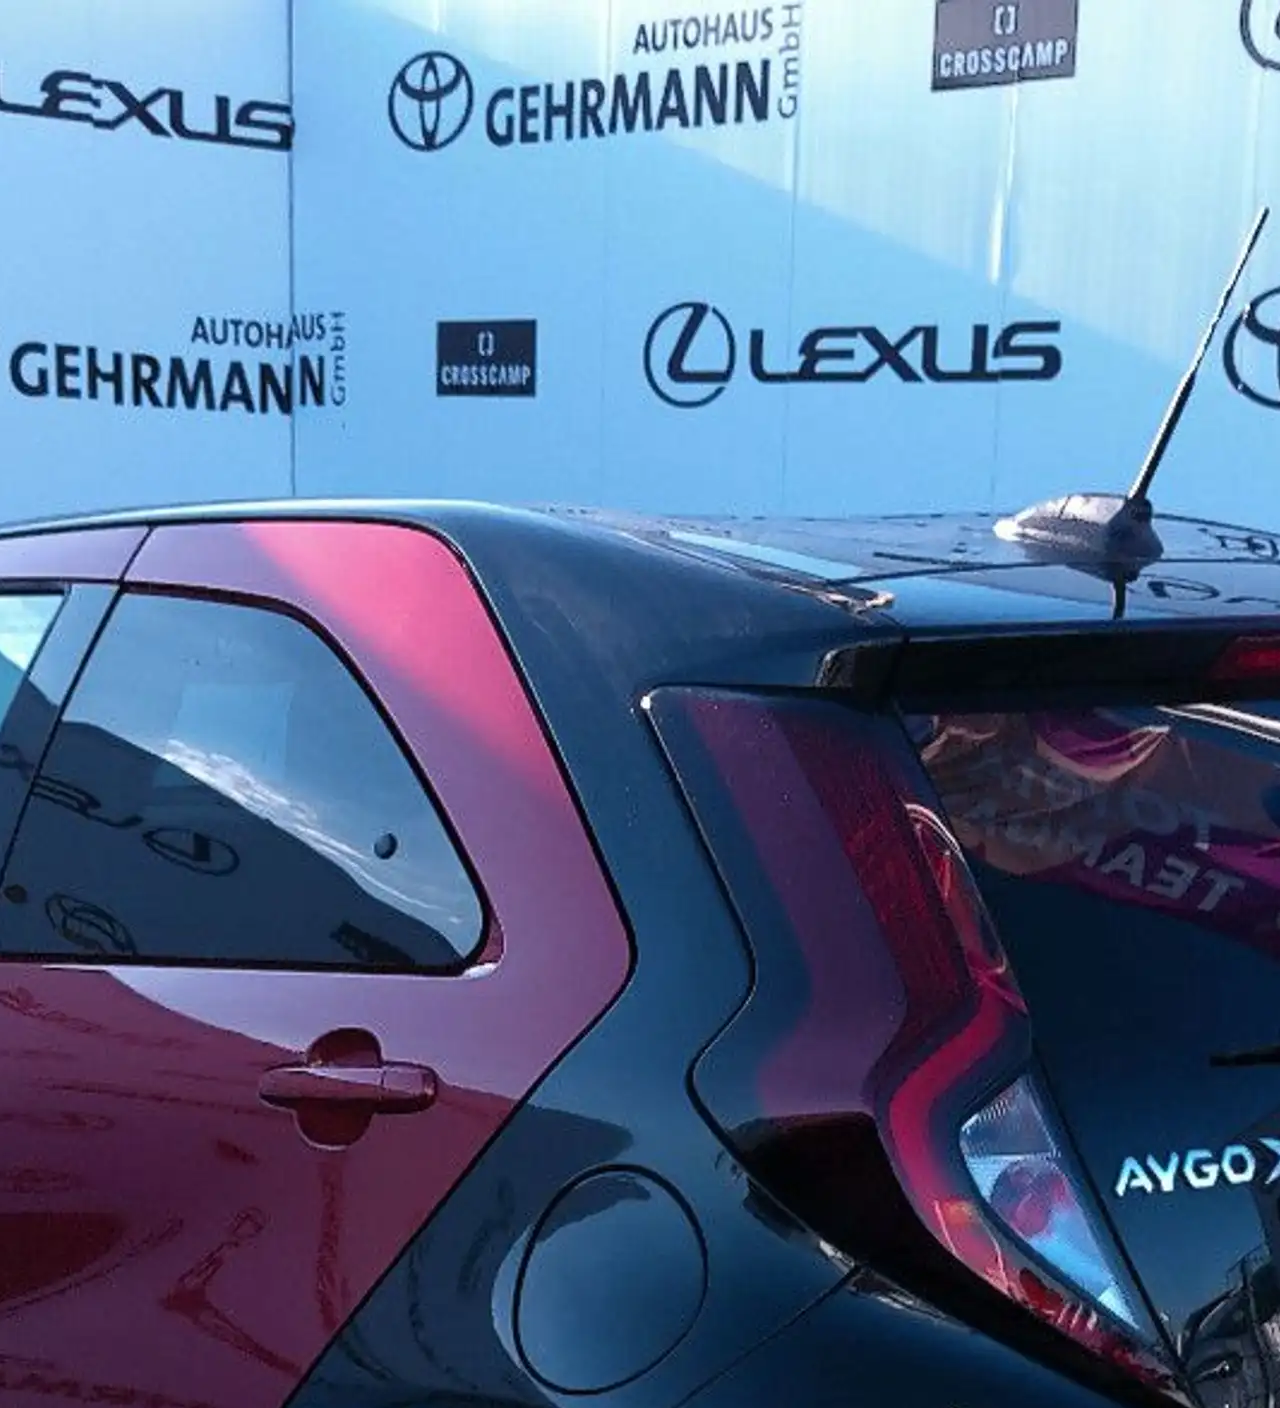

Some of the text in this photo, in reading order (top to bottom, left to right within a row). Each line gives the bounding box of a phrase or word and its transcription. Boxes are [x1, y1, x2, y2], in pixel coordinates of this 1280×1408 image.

[632, 8, 774, 55] AUTOHAUS
[777, 3, 802, 120] GmbH
[939, 39, 1070, 78] CROSSCAMP
[485, 59, 771, 147] GEHRMANN
[190, 314, 327, 350] AUTOHAUS
[330, 312, 347, 407] GmbH
[749, 320, 1062, 384] LEXUS
[9, 342, 326, 416] GEHRMANN
[1115, 1145, 1256, 1198] AYGO
